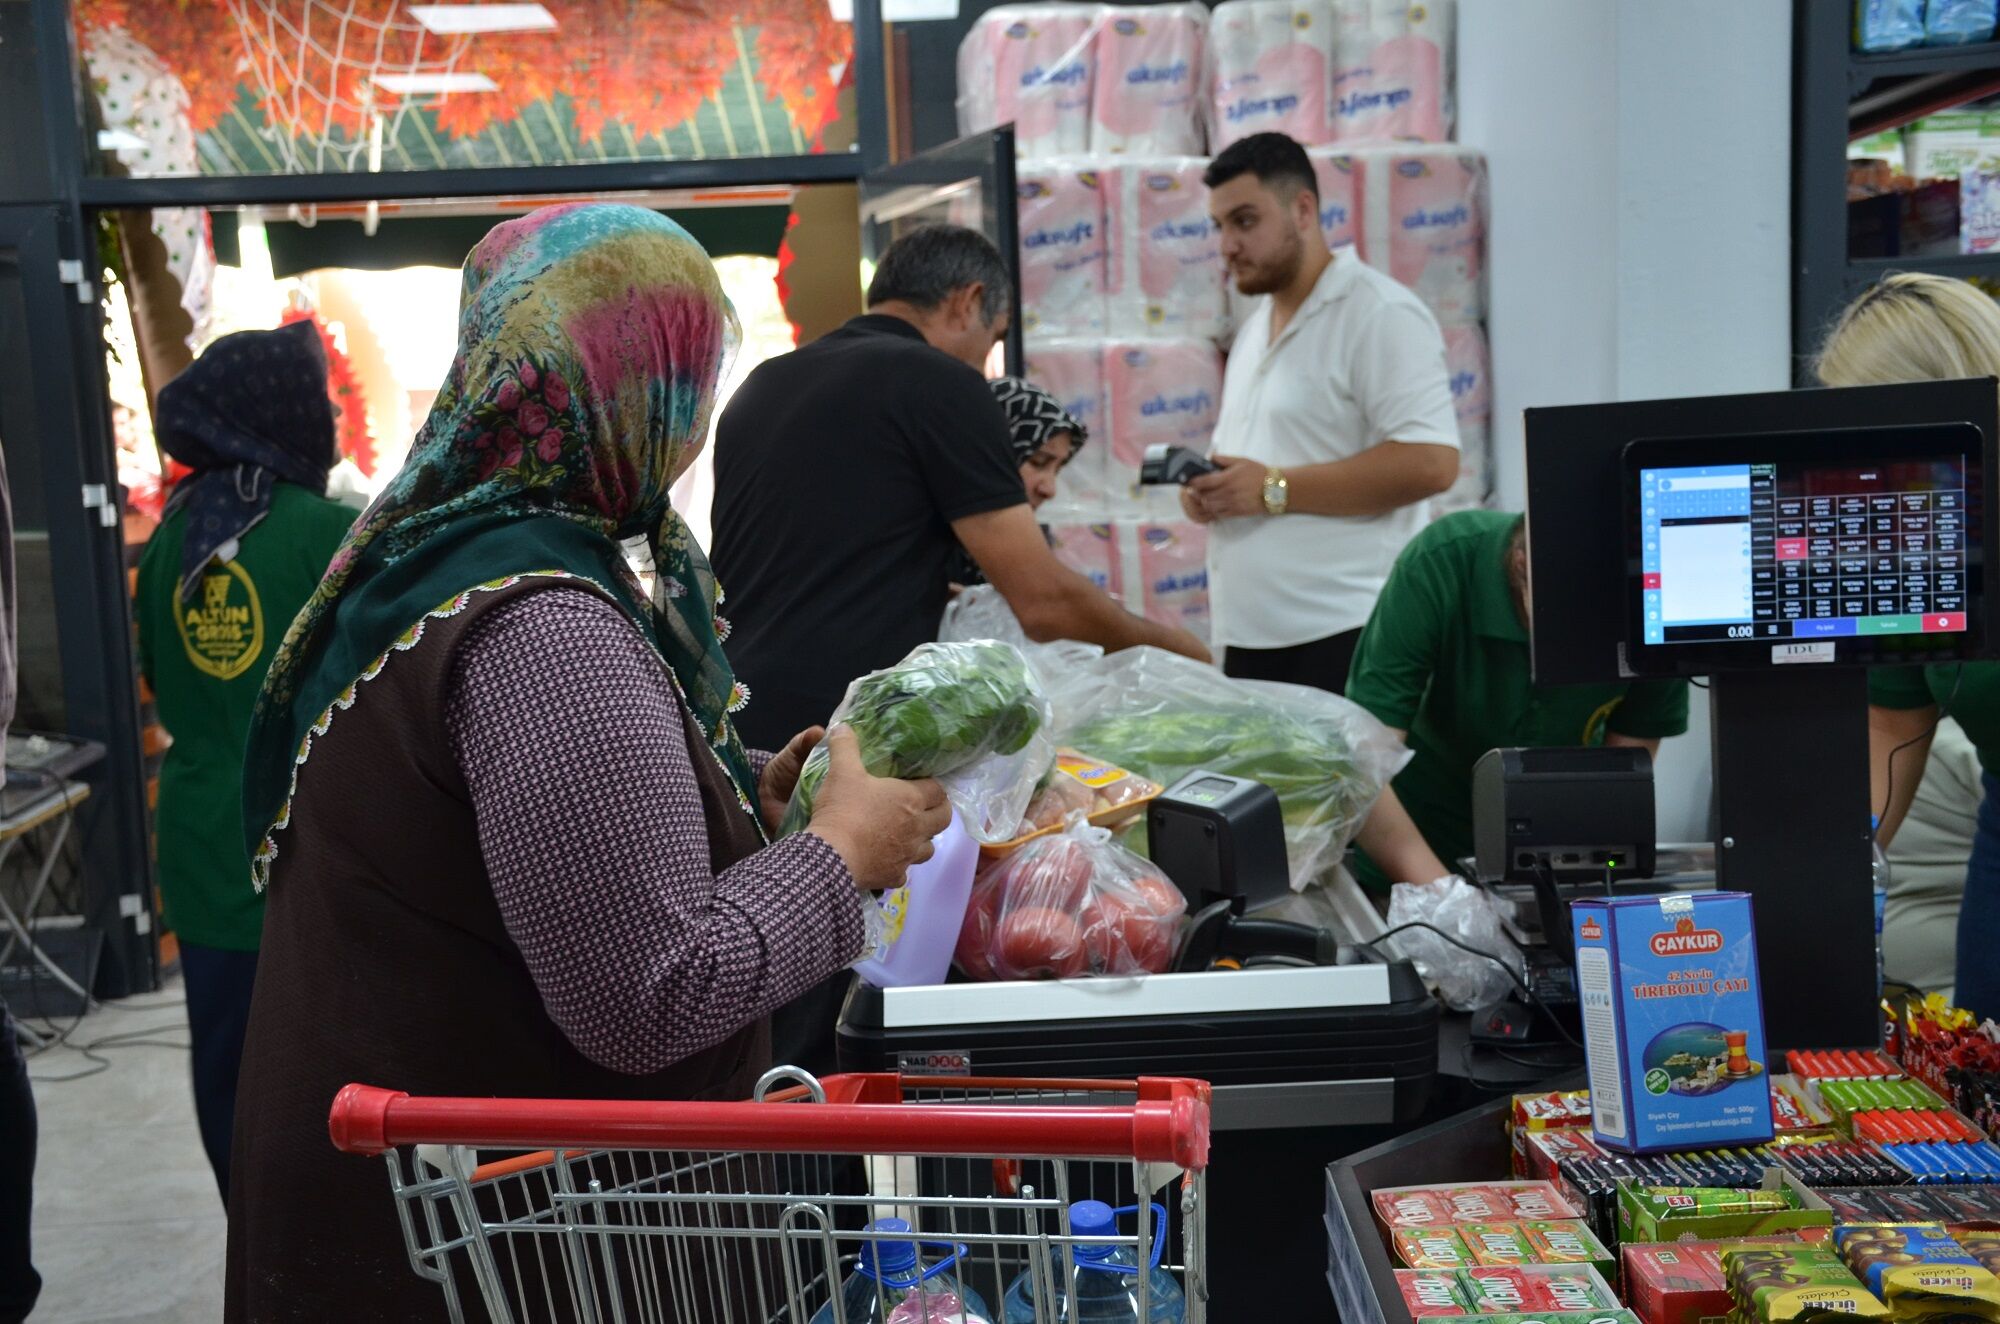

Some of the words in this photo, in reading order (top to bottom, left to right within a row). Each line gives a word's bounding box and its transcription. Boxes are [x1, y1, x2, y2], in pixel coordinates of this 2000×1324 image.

[1728, 626, 1753, 638] 0.00
[1654, 934, 1719, 954] ÇAYKUR
[1667, 971, 1681, 981] 42
[1634, 981, 1710, 999] TİREBOLU
[1712, 977, 1749, 997] ÇAYI
[1394, 1199, 1435, 1223] ONEO
[1452, 1194, 1493, 1217] ONEO
[1512, 1192, 1555, 1214] ONEO
[1418, 1238, 1461, 1262] ONEO
[1480, 1233, 1524, 1257] ONEO
[1543, 1231, 1588, 1255] ONEO
[1412, 1279, 1456, 1306] ONEO
[1479, 1277, 1524, 1305] ONEO
[1919, 1277, 1973, 1290] ÜLKER
[1546, 1282, 1594, 1309] ONEO
[1795, 1290, 1851, 1301] Çikolata
